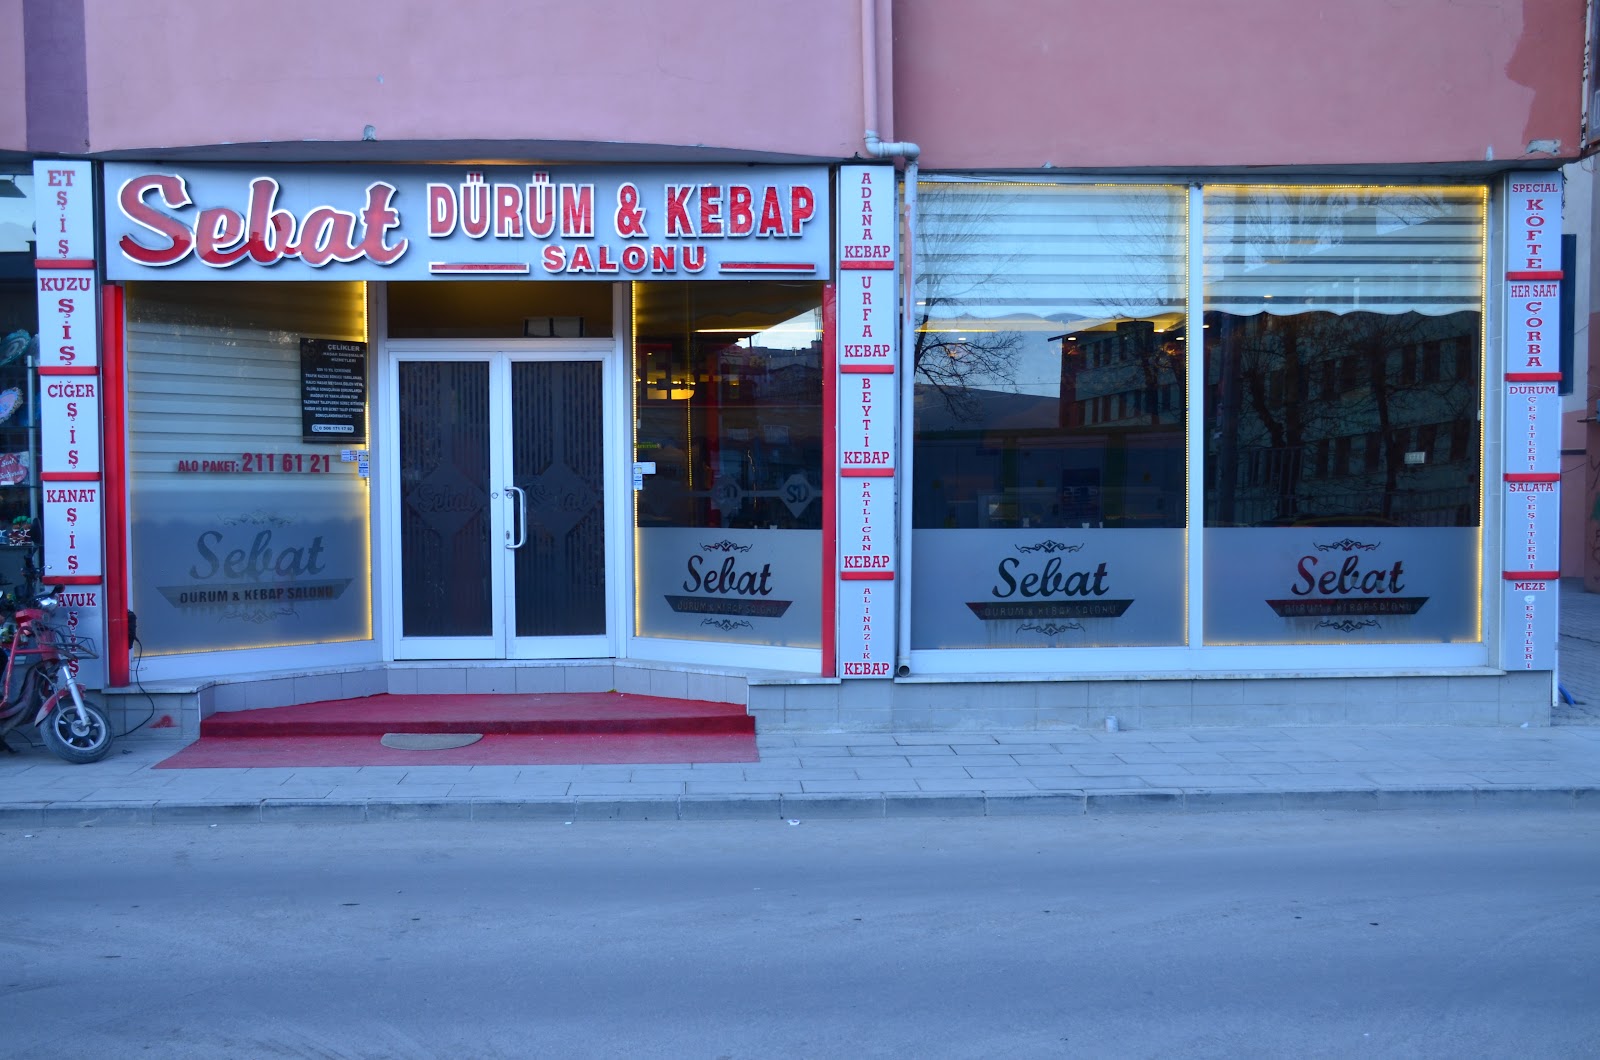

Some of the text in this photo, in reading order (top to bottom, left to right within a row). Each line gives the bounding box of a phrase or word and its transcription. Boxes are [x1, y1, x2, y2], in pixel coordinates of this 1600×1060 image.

[47, 170, 76, 187] ET
[426, 171, 817, 239] DÜRÜM & KEBAP
[861, 172, 873, 240] ADANA
[118, 172, 409, 268] Sebat
[1525, 199, 1545, 269] KÖFTE
[541, 243, 707, 274] SALONU
[844, 245, 891, 258] KEBAP
[40, 277, 92, 292] KUZU
[1511, 284, 1558, 298] HER SAAT
[861, 276, 873, 337] URFA
[1525, 301, 1543, 367] ÇORBA
[844, 344, 890, 358] KEBAP
[47, 380, 96, 398] CİĞER
[1509, 383, 1556, 395] DÜRÜM
[178, 460, 199, 472] ALO
[202, 460, 240, 472] PAKET:
[242, 452, 274, 472] 211
[282, 453, 303, 472] 61
[310, 454, 330, 473] 21
[843, 451, 890, 464] KEBAP
[46, 489, 96, 503] KANAT
[1509, 482, 1554, 493] SALATA
[189, 529, 326, 580] Sebat
[843, 555, 890, 569] KEBAP
[683, 555, 773, 596] Sebat
[991, 556, 1110, 598] Sebat
[1290, 555, 1405, 596] Sebat
[244, 587, 284, 601] KEBAP
[1514, 582, 1546, 591] MEZE
[58, 592, 97, 607] AVUK
[844, 662, 890, 675] KEBAP
